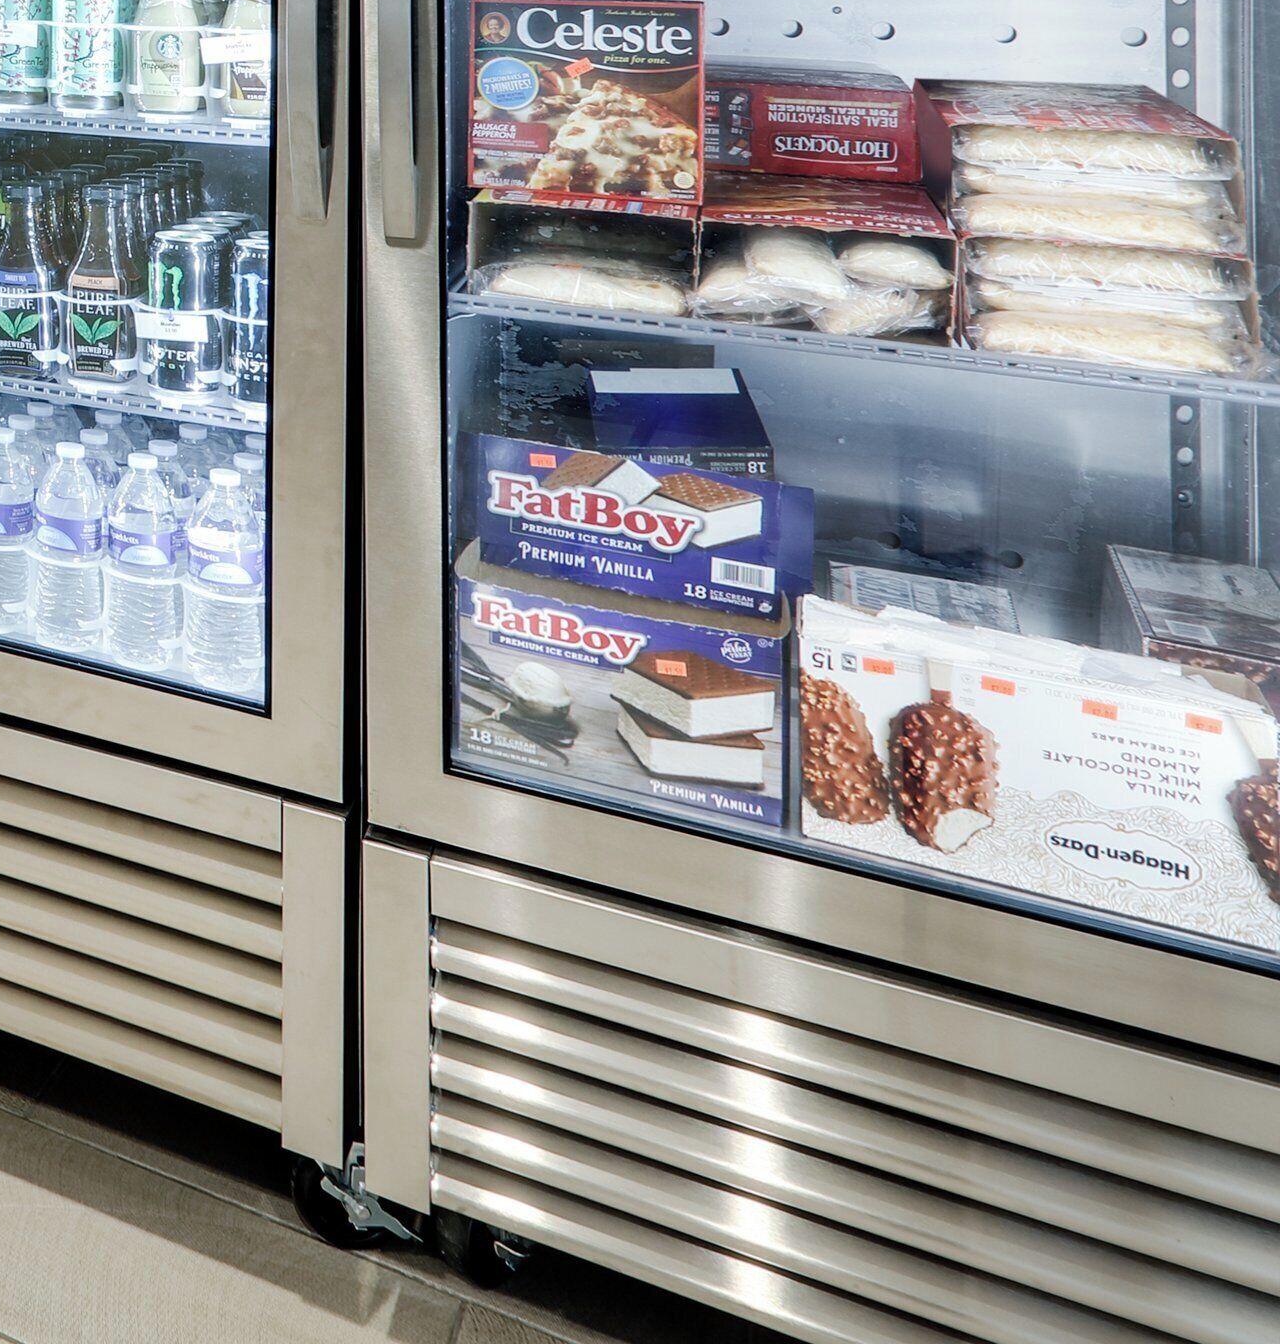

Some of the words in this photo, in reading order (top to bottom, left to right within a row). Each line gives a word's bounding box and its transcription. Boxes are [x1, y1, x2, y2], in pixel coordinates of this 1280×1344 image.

[516, 7, 693, 55] Celeste
[9, 56, 32, 66] Green
[604, 55, 629, 63] pizza
[630, 56, 646, 64] for
[647, 56, 665, 64] one
[768, 111, 860, 125] SATISFACTION
[863, 116, 898, 128] REAL
[775, 136, 850, 156] POCKETS
[853, 142, 889, 158] HOT
[0, 297, 33, 309] LEAF
[76, 302, 113, 315] LEAF
[0, 339, 24, 348] BREWED
[24, 342, 37, 350] TEA
[77, 345, 101, 354] BREWED
[102, 347, 113, 356] TEA
[493, 476, 695, 547] FatBoy
[521, 523, 576, 540] PREMIUM
[578, 533, 598, 545] ICE
[600, 537, 643, 553] CREAM
[518, 541, 585, 569] PREMIUM
[591, 555, 654, 582] VANILLA
[683, 582, 707, 599] 18
[709, 590, 724, 598] ICE
[725, 592, 754, 604] CREAM
[499, 636, 543, 652] PREMIUM
[545, 645, 563, 656] ICE
[564, 649, 599, 665] CREAM
[811, 652, 834, 671] 15
[1041, 748, 1152, 781] CHOCOLATE
[1120, 751, 1201, 775] ALMOND
[1157, 772, 1201, 790] MILK
[649, 779, 706, 804] PREMIUM
[711, 793, 764, 817] VANILLA
[1125, 780, 1202, 805] VANILLA
